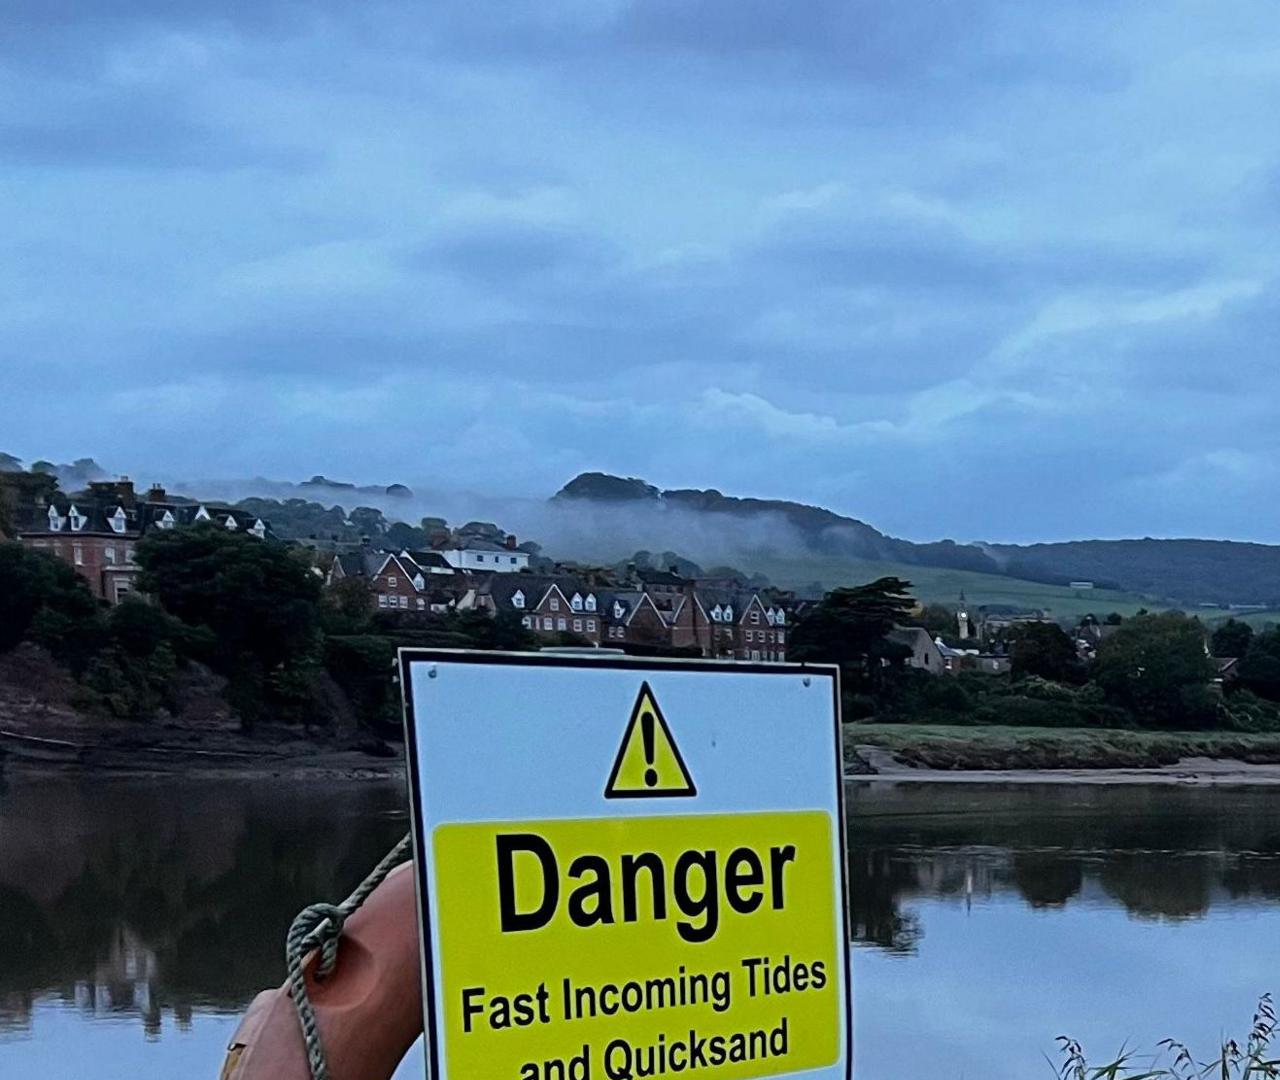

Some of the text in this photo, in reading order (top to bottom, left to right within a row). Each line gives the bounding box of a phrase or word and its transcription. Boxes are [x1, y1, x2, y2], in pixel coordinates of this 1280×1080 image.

[495, 833, 796, 943] Danger
[462, 954, 827, 1033] Fast Incoming Tides
